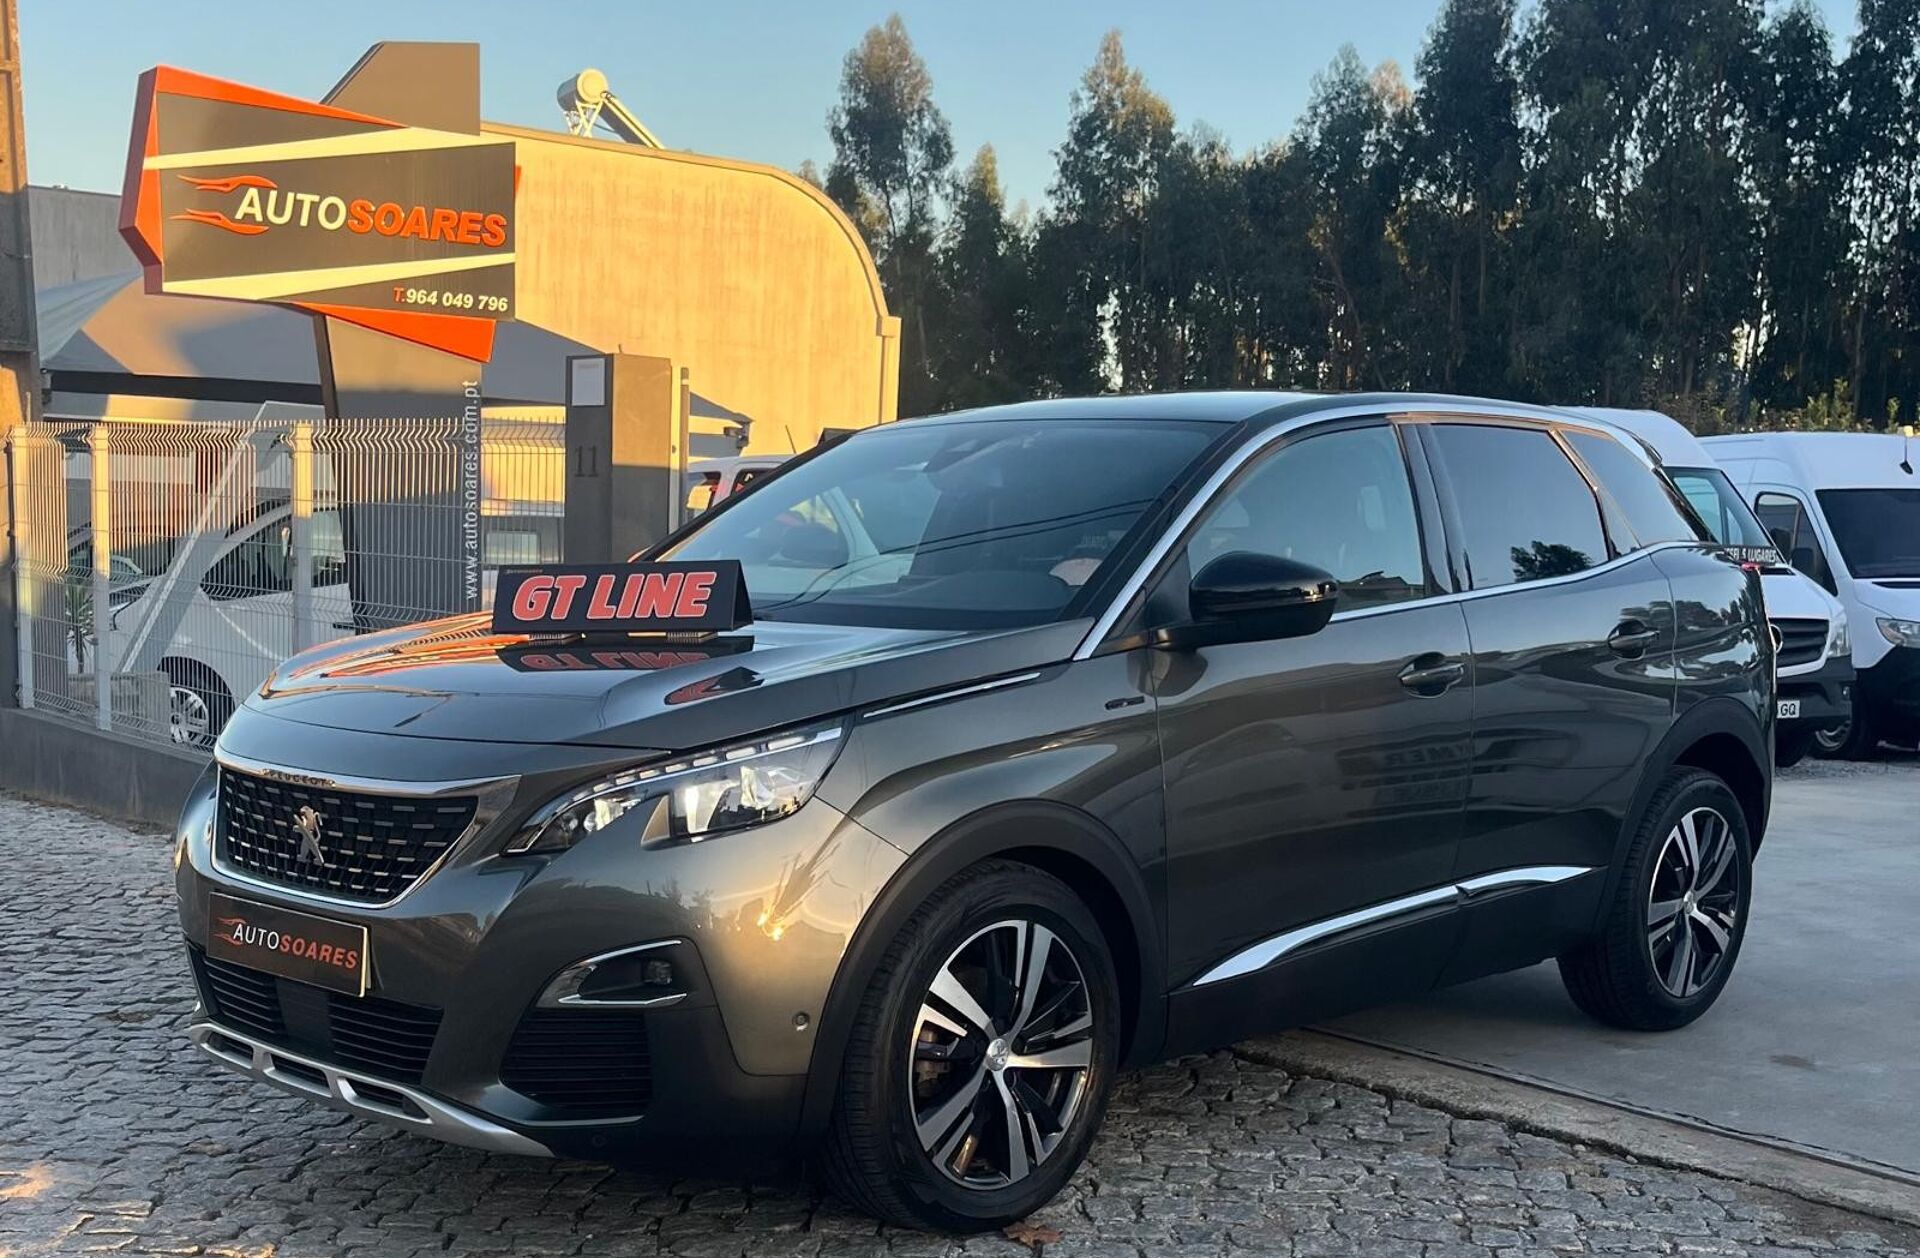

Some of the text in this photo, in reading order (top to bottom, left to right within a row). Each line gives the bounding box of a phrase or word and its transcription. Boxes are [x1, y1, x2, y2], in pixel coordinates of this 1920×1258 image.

[442, 293, 475, 310] 049
[477, 294, 509, 313] 796
[574, 445, 599, 477] 11
[462, 380, 479, 600] www.autosoares.com.pt
[512, 571, 717, 621] GT LINE
[268, 768, 328, 787] PEUGEOT
[232, 922, 360, 969] AUTOSOARES
